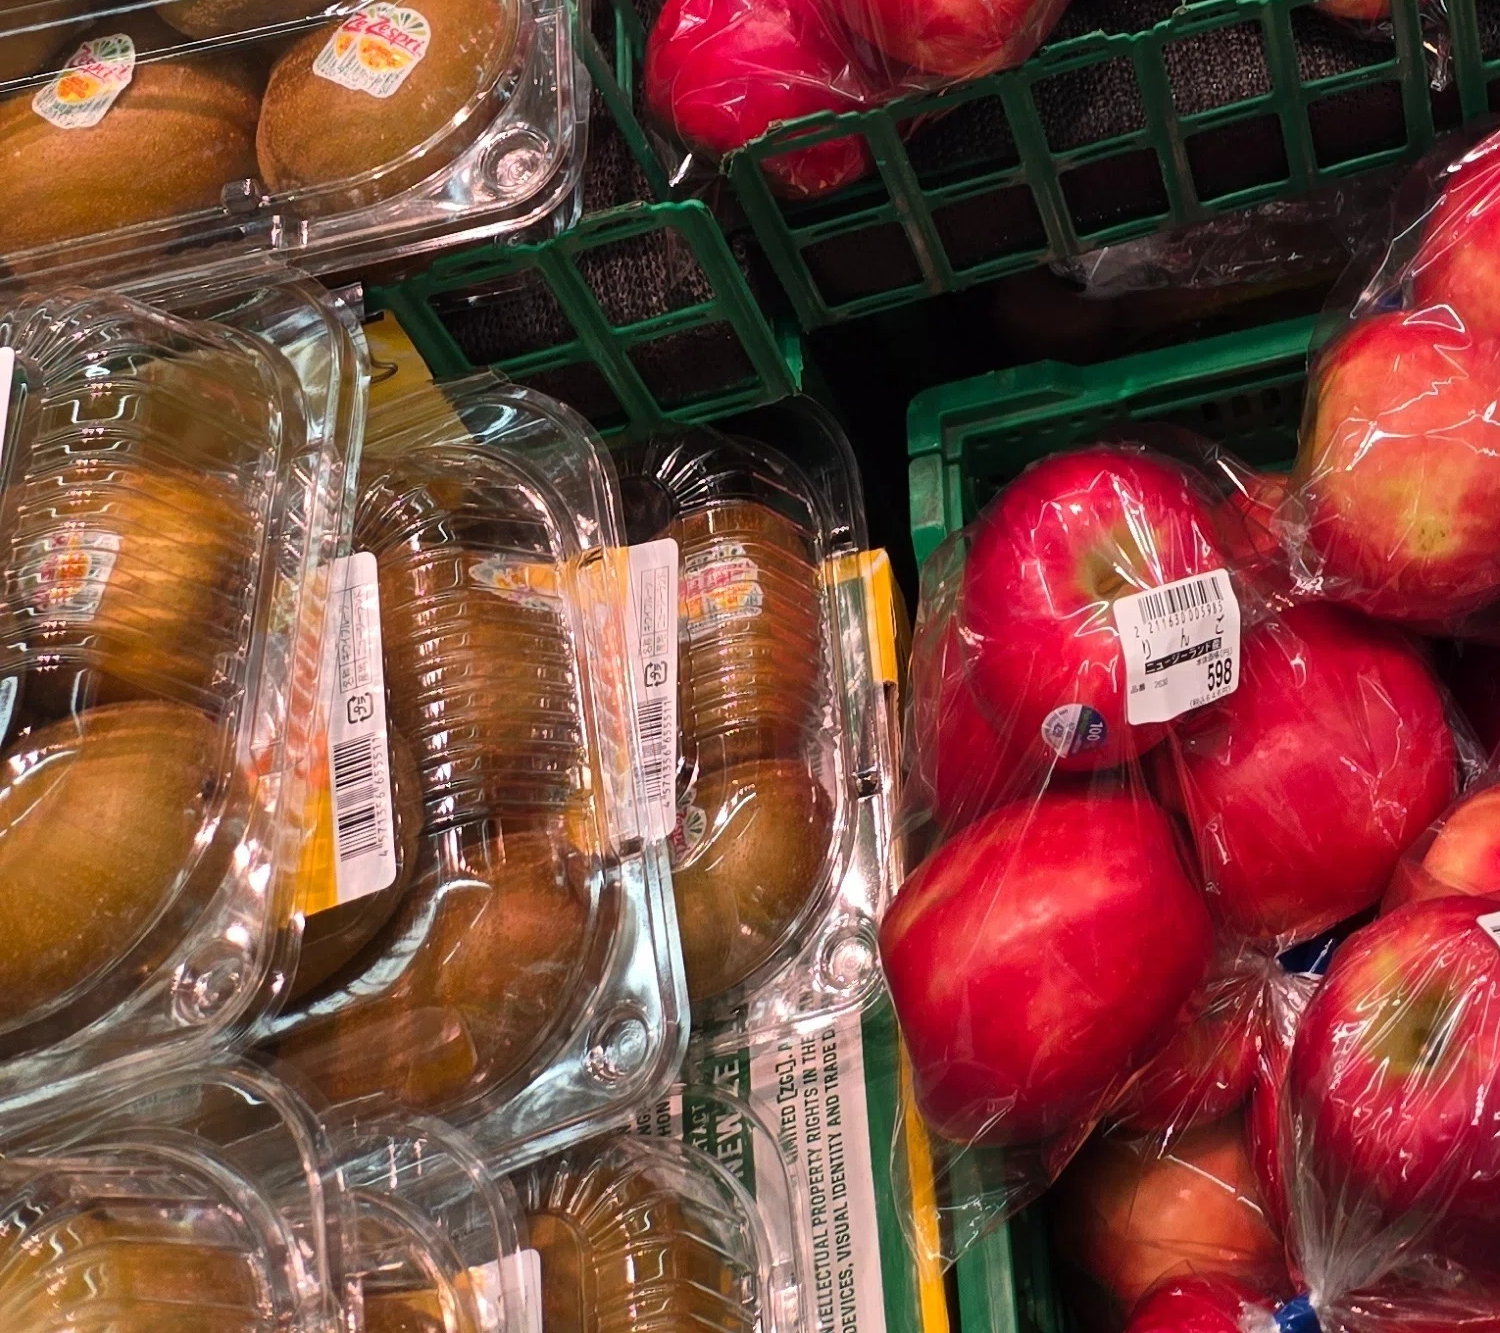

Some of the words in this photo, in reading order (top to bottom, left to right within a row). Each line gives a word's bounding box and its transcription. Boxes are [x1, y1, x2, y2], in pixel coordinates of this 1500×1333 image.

[1140, 617, 1226, 660] りんご
[1144, 636, 1223, 675] ニュージーランド産
[1206, 657, 1234, 691] 598
[801, 1035, 818, 1065] THE
[822, 1043, 839, 1091] TRADE
[803, 1067, 818, 1084] IN
[803, 1087, 822, 1144] RIGHTS
[824, 1094, 840, 1127] AND
[714, 1111, 744, 1179] NEW
[827, 1129, 848, 1200] IDENTITY
[807, 1147, 828, 1227] PROPERTY
[833, 1203, 854, 1263] VISUAL
[812, 1228, 836, 1333] NTELLECTUAL
